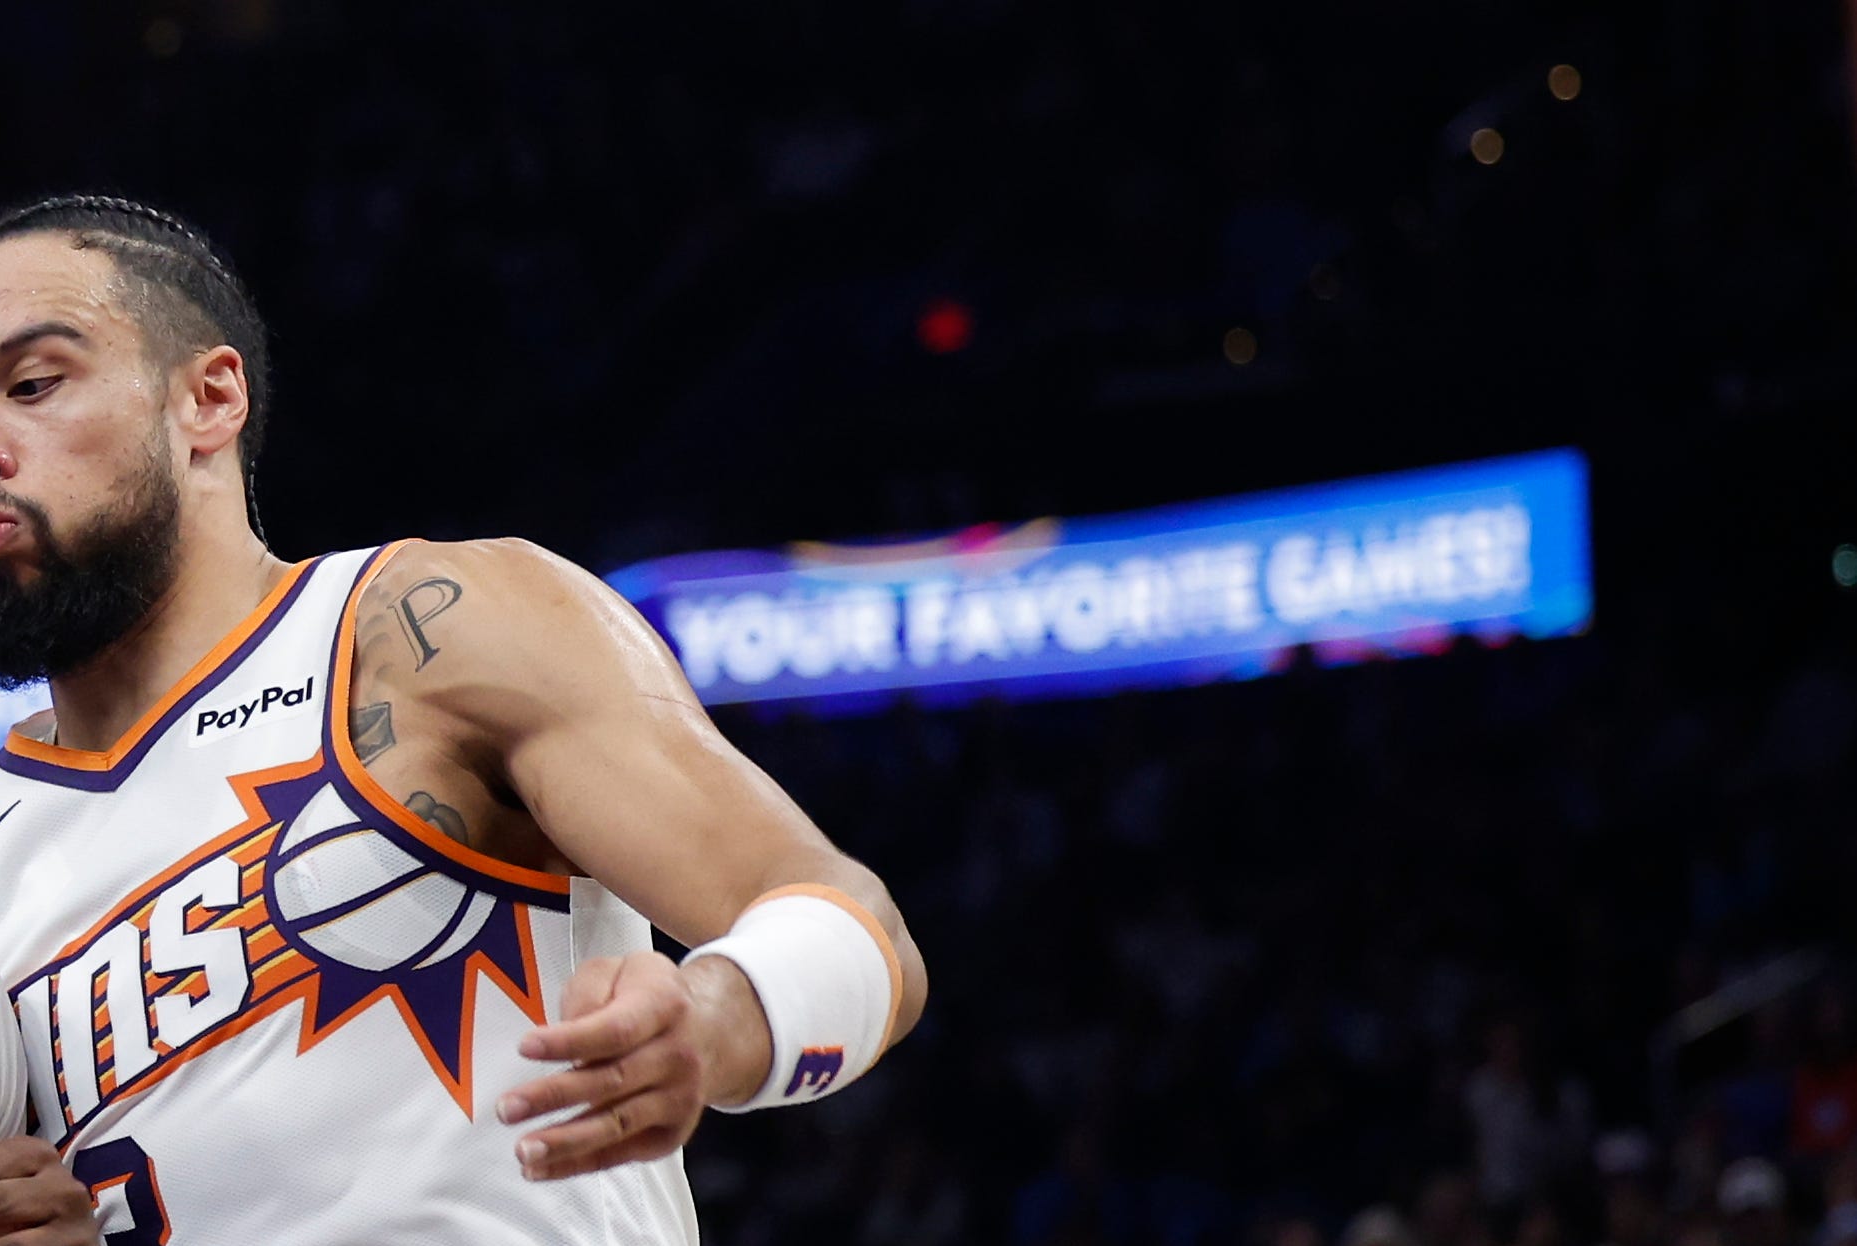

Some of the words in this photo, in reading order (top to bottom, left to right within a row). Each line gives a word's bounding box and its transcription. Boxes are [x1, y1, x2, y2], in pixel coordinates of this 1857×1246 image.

[665, 588, 899, 687] YOUR
[903, 542, 1263, 667] FAVORITE
[196, 676, 314, 737] PayPal
[15, 854, 253, 1144] NS
